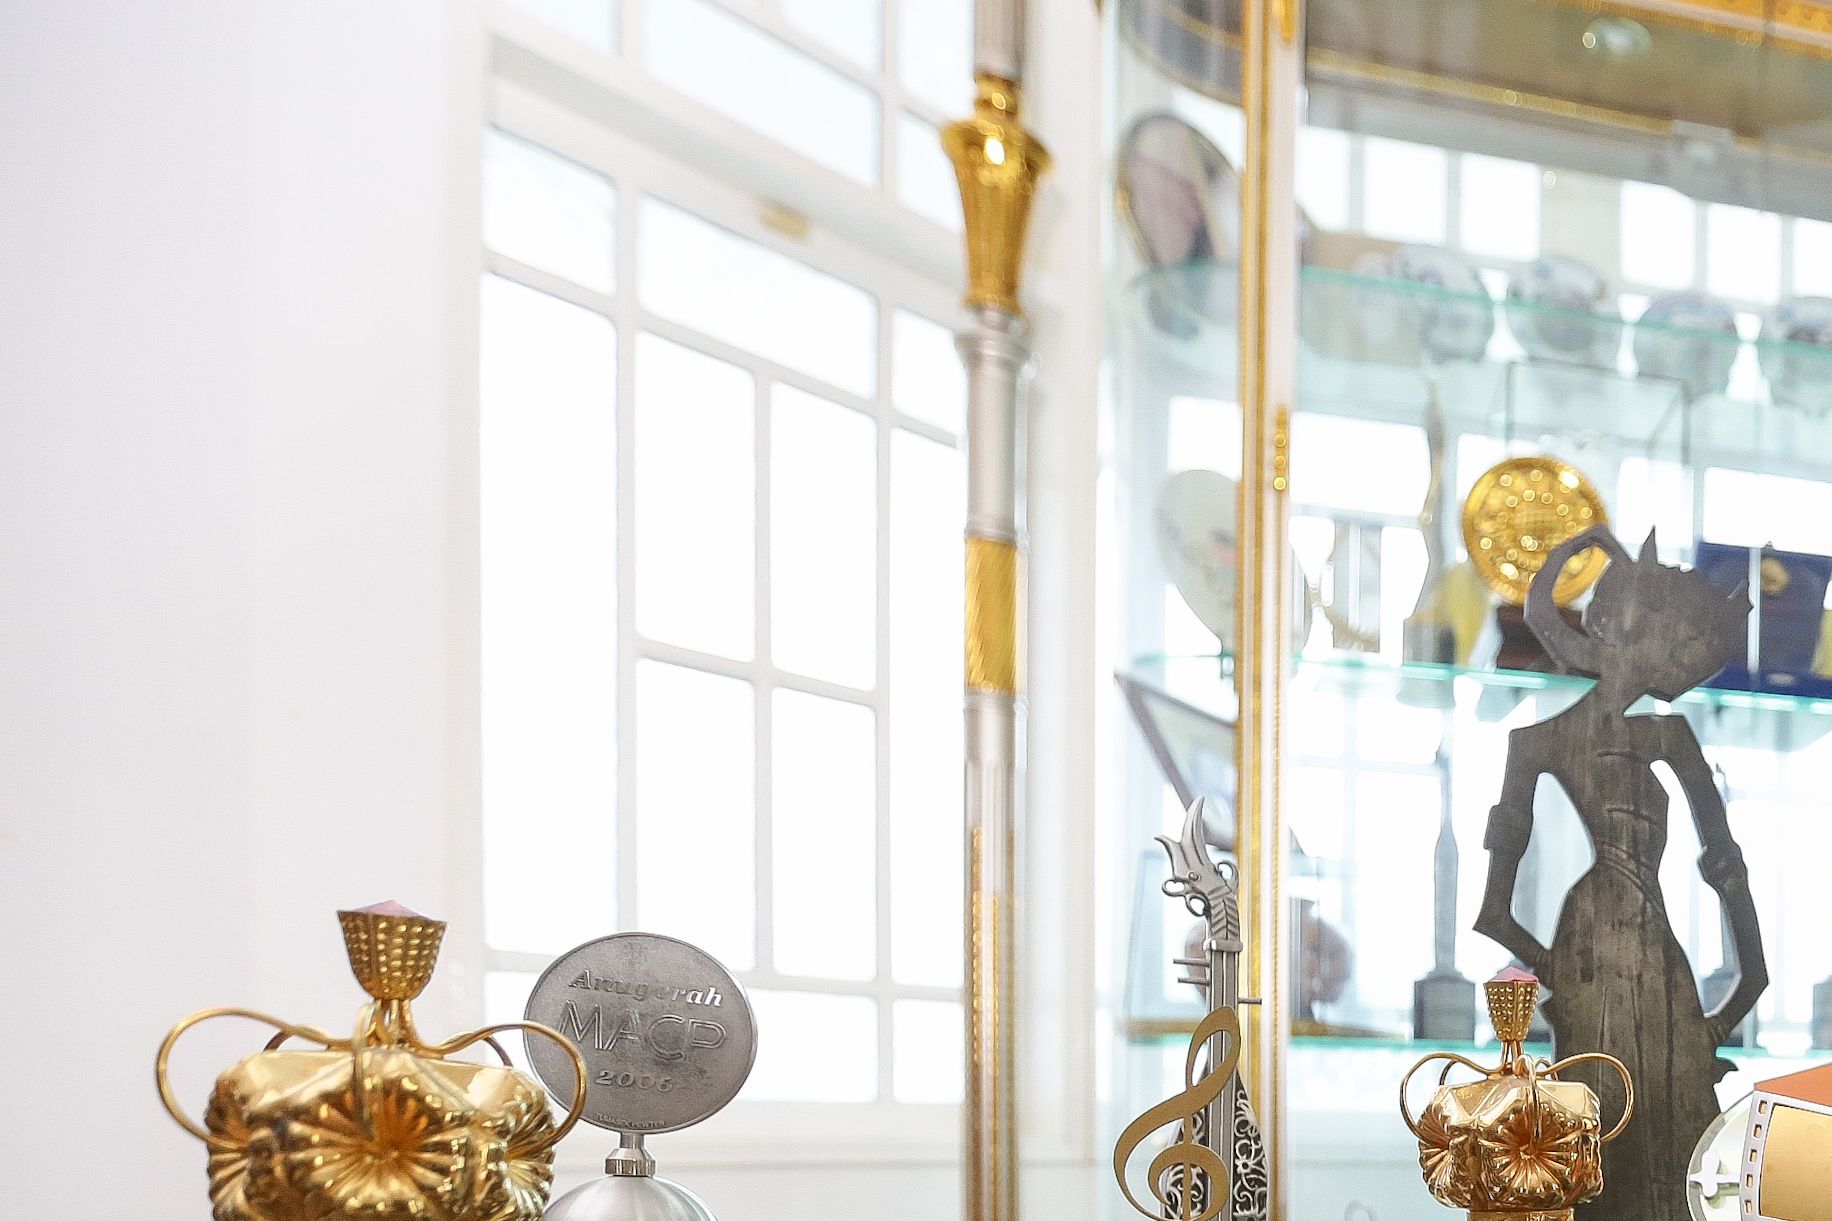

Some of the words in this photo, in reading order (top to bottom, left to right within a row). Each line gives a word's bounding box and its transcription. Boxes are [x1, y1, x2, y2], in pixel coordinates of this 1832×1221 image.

[568, 969, 723, 1007] Anugerah
[559, 1000, 727, 1062] MACP
[596, 1069, 674, 1093] 2006
